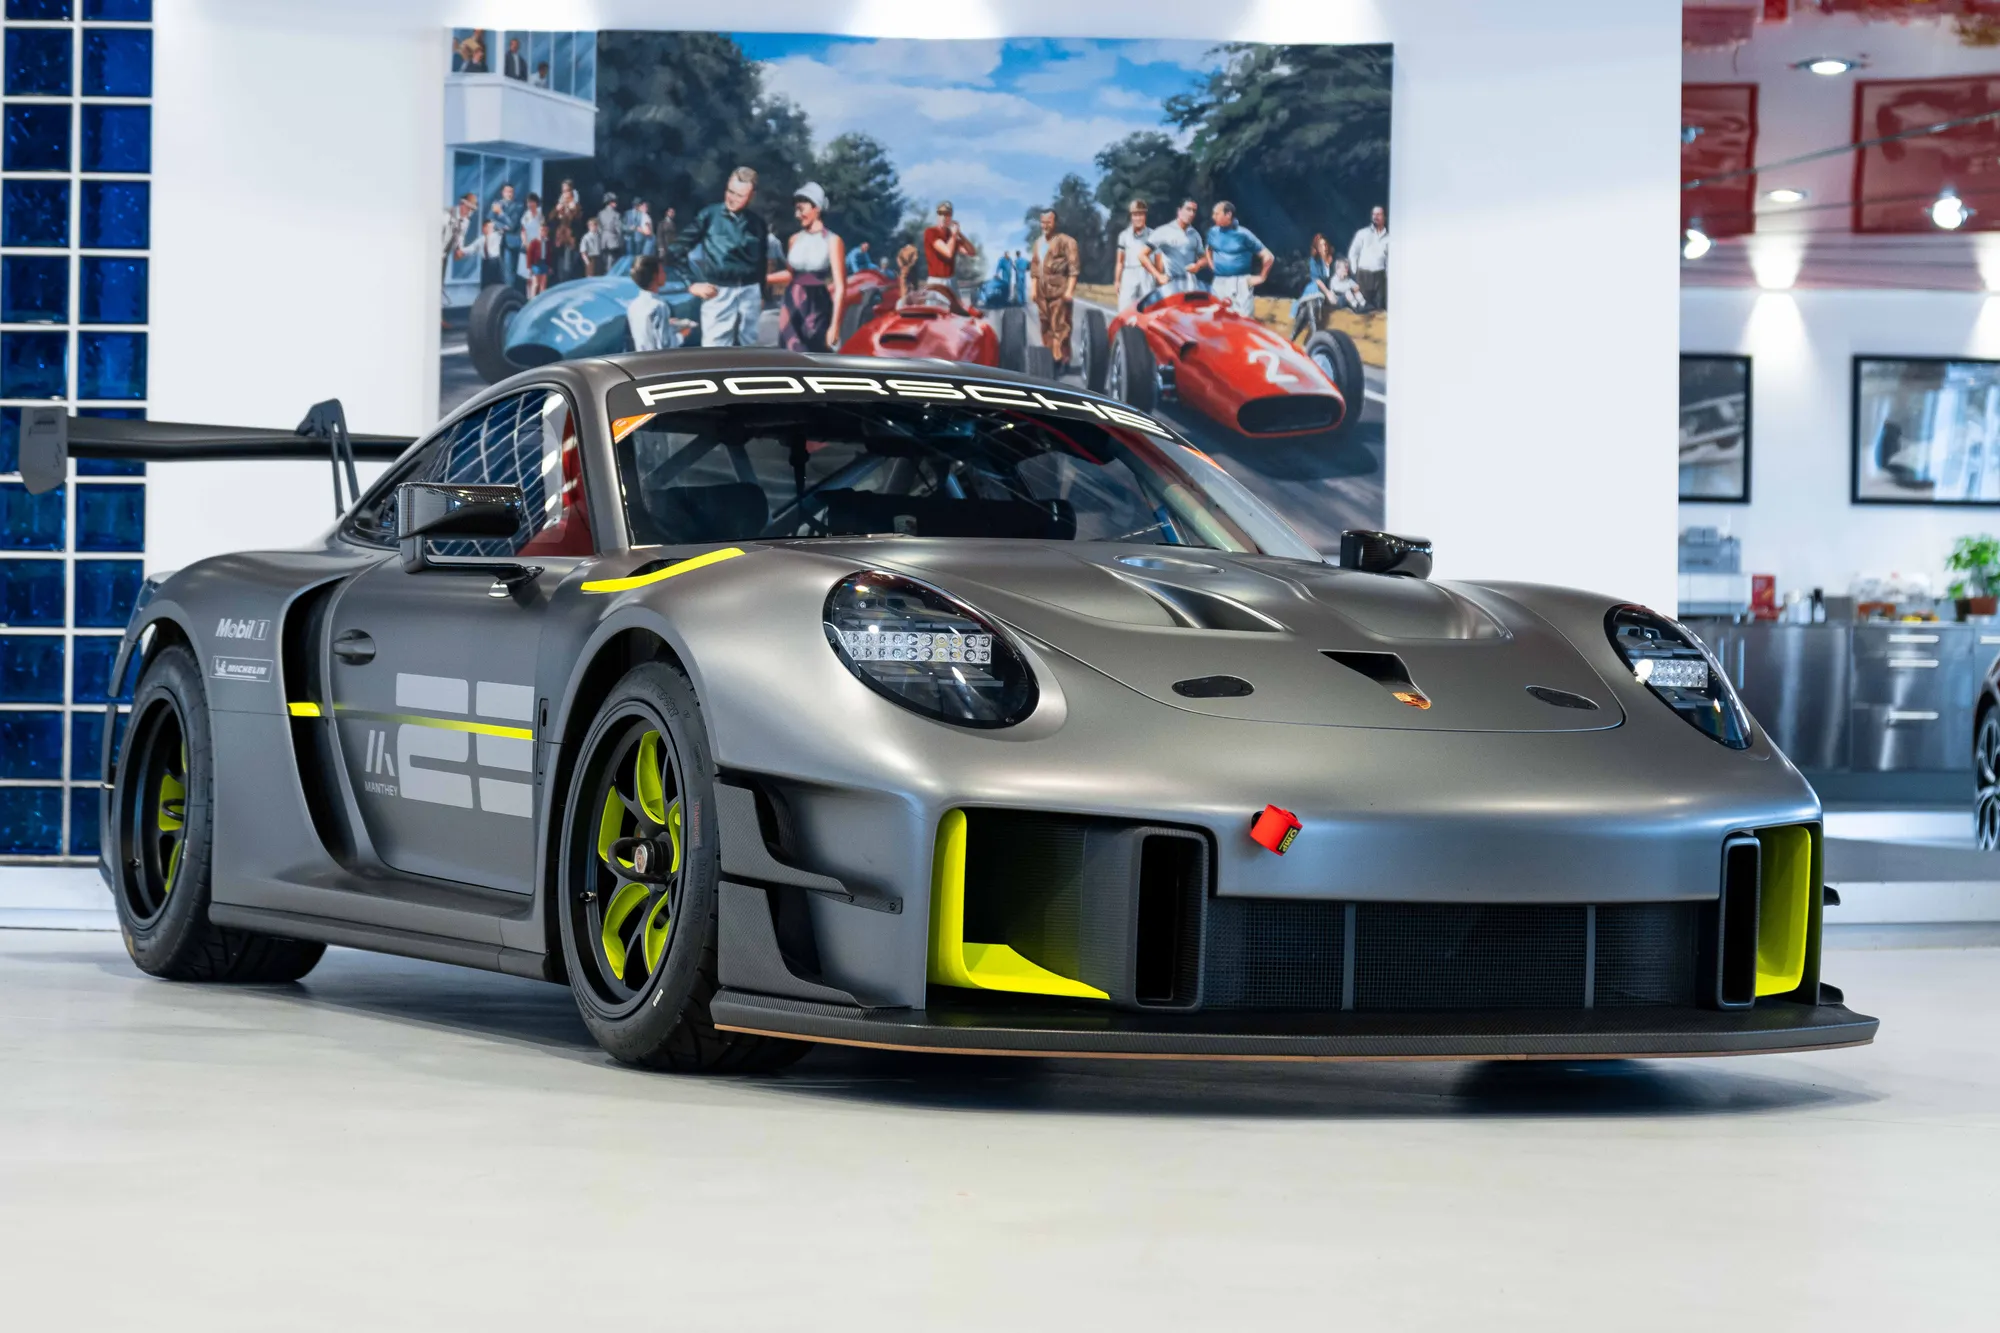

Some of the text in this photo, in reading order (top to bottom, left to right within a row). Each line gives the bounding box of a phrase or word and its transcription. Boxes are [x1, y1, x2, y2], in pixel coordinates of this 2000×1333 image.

[550, 308, 596, 340] 18
[1248, 351, 1299, 383] 2
[636, 376, 1174, 440] PORSCHE
[216, 618, 256, 639] Mobil
[226, 664, 267, 675] MICHELIN
[364, 780, 398, 797] MANTHEY
